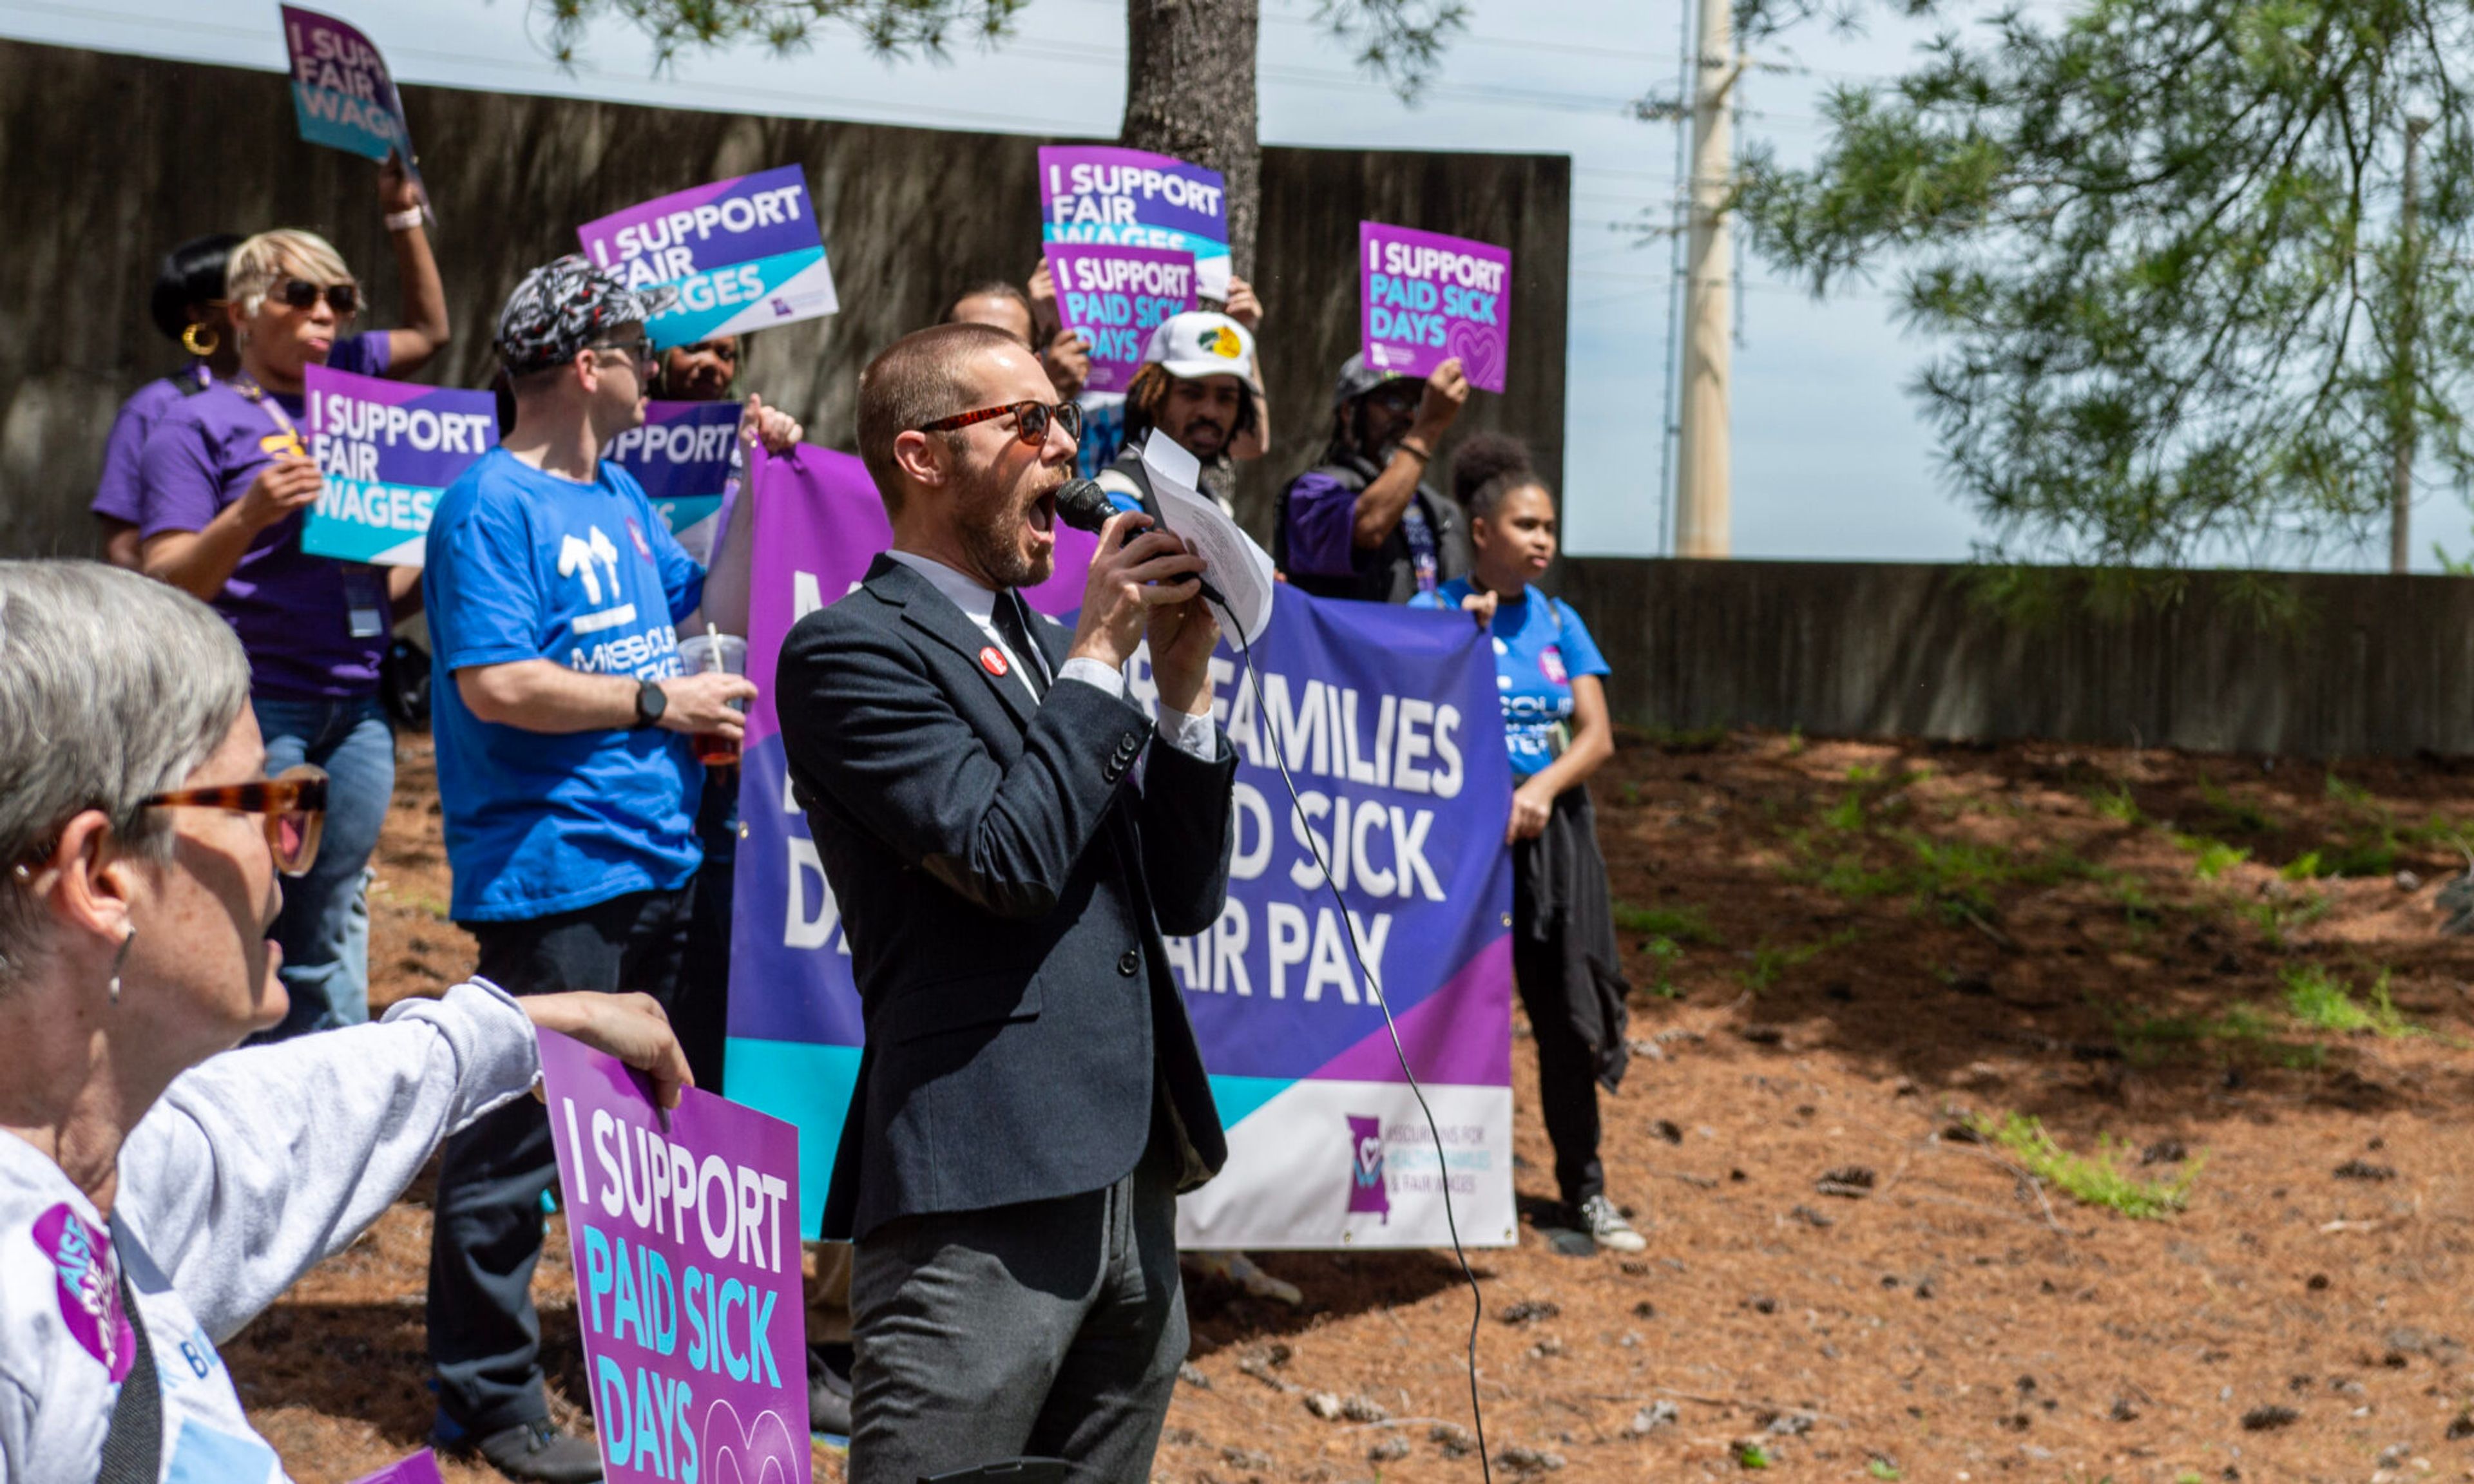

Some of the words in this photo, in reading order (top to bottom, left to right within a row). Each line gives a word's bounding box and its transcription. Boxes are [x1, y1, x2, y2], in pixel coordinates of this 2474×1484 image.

[291, 22, 303, 54] I
[297, 55, 378, 103] FAIR
[1049, 164, 1062, 195] I
[1071, 163, 1222, 217] SUPPORT
[1051, 195, 1138, 225] FAIR
[593, 238, 609, 268] I
[616, 184, 803, 261] SUPPORT
[644, 264, 765, 321] GES
[1056, 257, 1071, 291] I
[1075, 257, 1192, 298] SUPPORT
[1369, 238, 1380, 272] I
[1385, 241, 1505, 294] SUPPORT
[1066, 292, 1131, 325] PAID
[1370, 272, 1437, 312] PAID
[1443, 284, 1499, 326] SICK
[1370, 306, 1447, 348] DAYS
[312, 389, 322, 431] I
[327, 393, 492, 455] SUPPORT
[600, 423, 736, 465] PPORT
[312, 433, 379, 485] FAIR
[315, 474, 434, 533] WAGES
[1206, 656, 1464, 800] FAMILIES
[1290, 790, 1447, 902] SICK
[1267, 901, 1393, 1007] PAY
[563, 1097, 589, 1204] I
[591, 1108, 787, 1274] SUPPORT
[583, 1224, 678, 1356] PAID
[682, 1265, 782, 1389] SICK
[597, 1354, 699, 1484] DAYS
